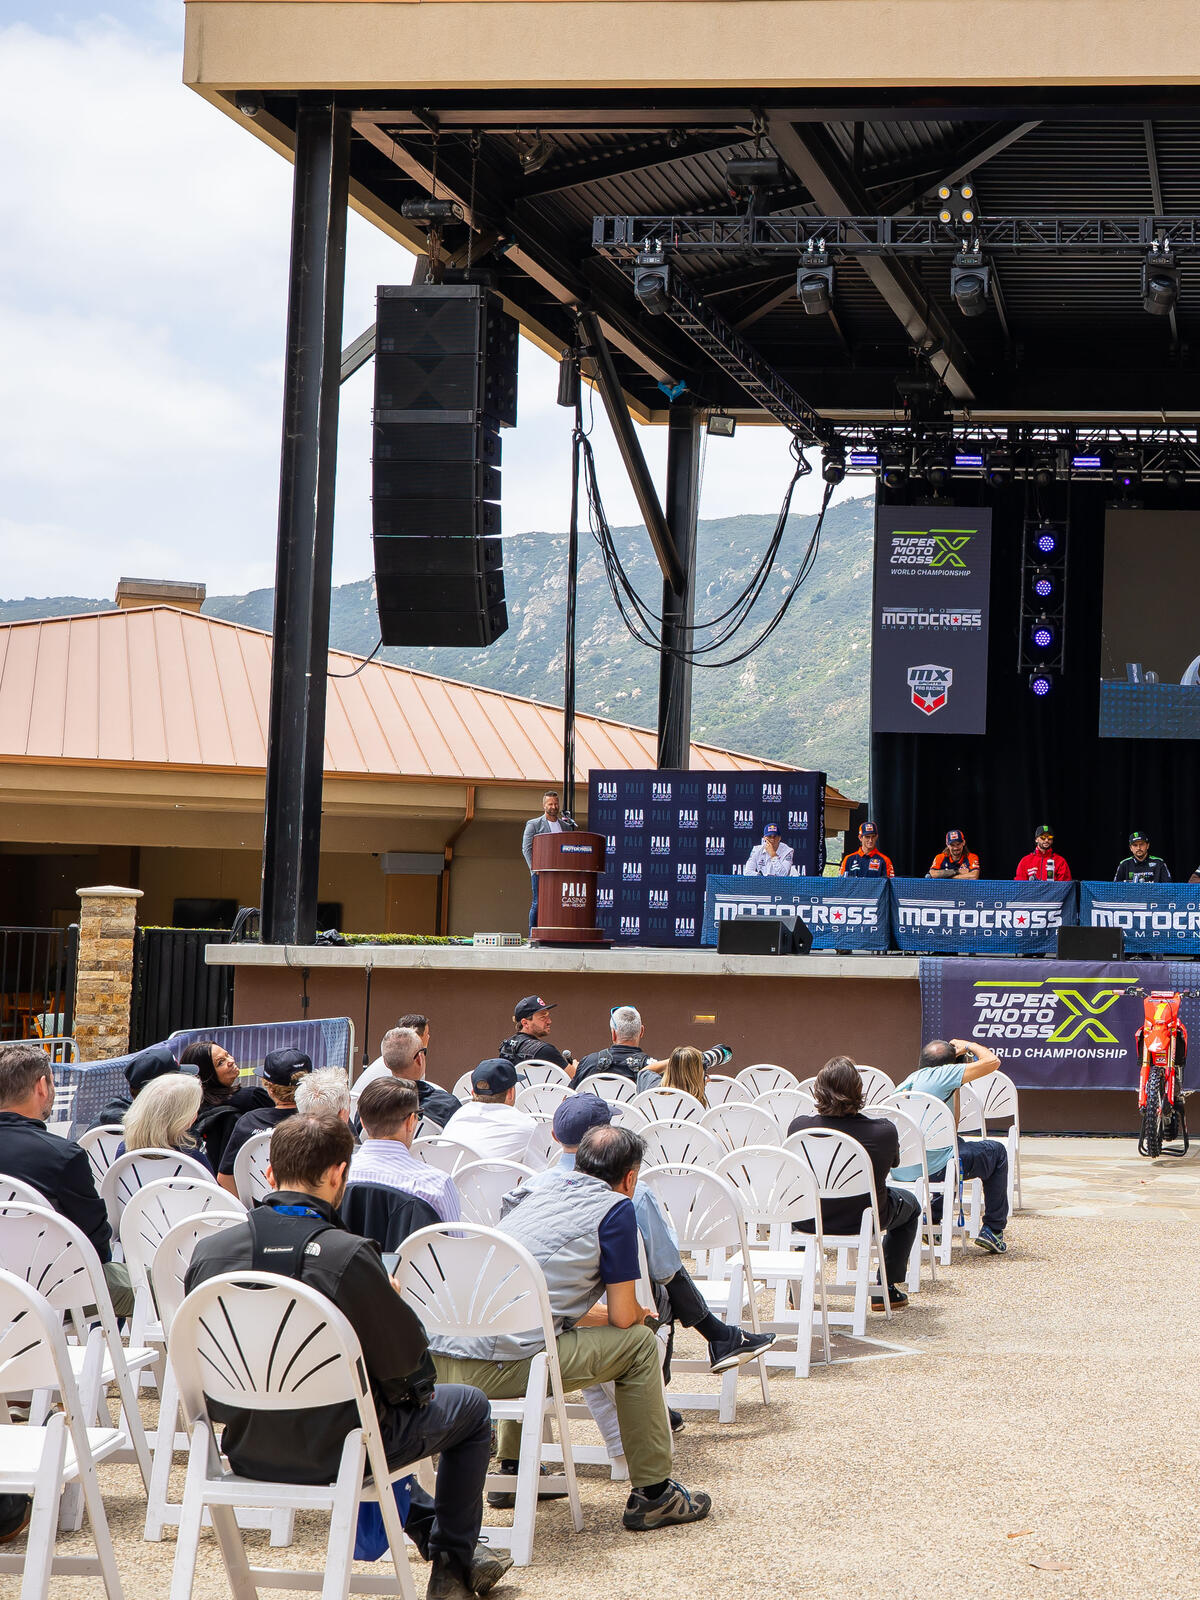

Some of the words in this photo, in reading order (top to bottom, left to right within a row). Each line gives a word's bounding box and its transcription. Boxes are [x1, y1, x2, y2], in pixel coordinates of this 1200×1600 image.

[891, 537, 936, 547] SUPER
[893, 547, 933, 556] MOTO
[890, 555, 934, 564] CROSS
[890, 568, 916, 576] WORLD
[917, 569, 971, 577] CHAMPIONSHIP
[881, 613, 982, 627] MOTOCROSS
[598, 782, 617, 793] PALA
[652, 783, 671, 793] PALA
[707, 784, 726, 794] PALA
[763, 784, 781, 794] PALA
[625, 809, 643, 820] PALA
[680, 810, 698, 820] PALA
[734, 810, 753, 821] PALA
[789, 812, 808, 822] PALA
[608, 836, 616, 846] LA
[651, 836, 670, 847] PALA
[706, 837, 724, 847] PALA
[623, 863, 642, 873] PALA
[678, 864, 696, 874] PALA
[562, 882, 586, 897] PALA
[650, 890, 668, 901] PALA
[714, 902, 878, 925] MOTOCROSS
[898, 907, 1063, 928] MOTOCROSS
[621, 917, 640, 928] PALA
[676, 918, 695, 929] PALA
[973, 993, 1059, 1008] SUPER
[978, 1009, 1054, 1023] MOTO
[1154, 1003, 1168, 1020] 1
[972, 1024, 1056, 1038] CROSS
[988, 1047, 1020, 1059] ORLD
[1024, 1048, 1128, 1059] CHAMPIONSHIP
